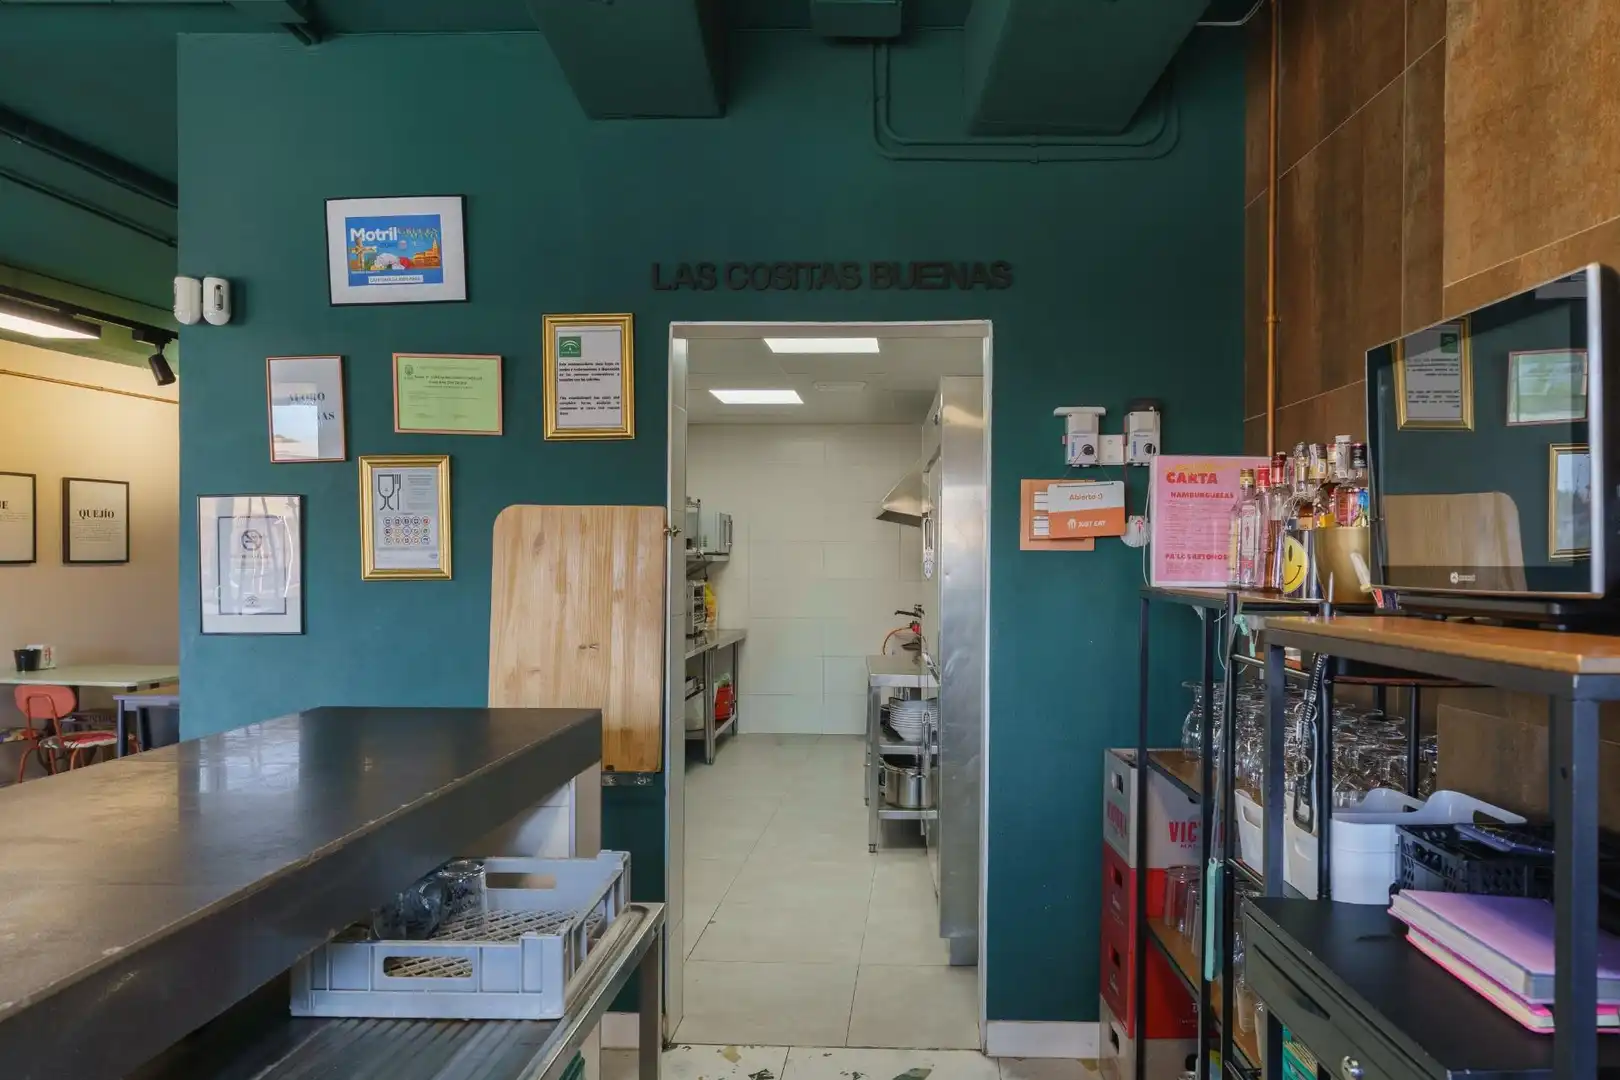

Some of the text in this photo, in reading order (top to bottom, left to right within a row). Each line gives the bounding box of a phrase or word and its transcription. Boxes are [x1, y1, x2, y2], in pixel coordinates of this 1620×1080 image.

[350, 227, 398, 242] Motril
[651, 260, 1015, 292] LAS COSITAS BUENAS
[1166, 472, 1218, 485] CARTA
[1069, 493, 1096, 501] Abierto
[78, 508, 115, 520] QUEJÍO
